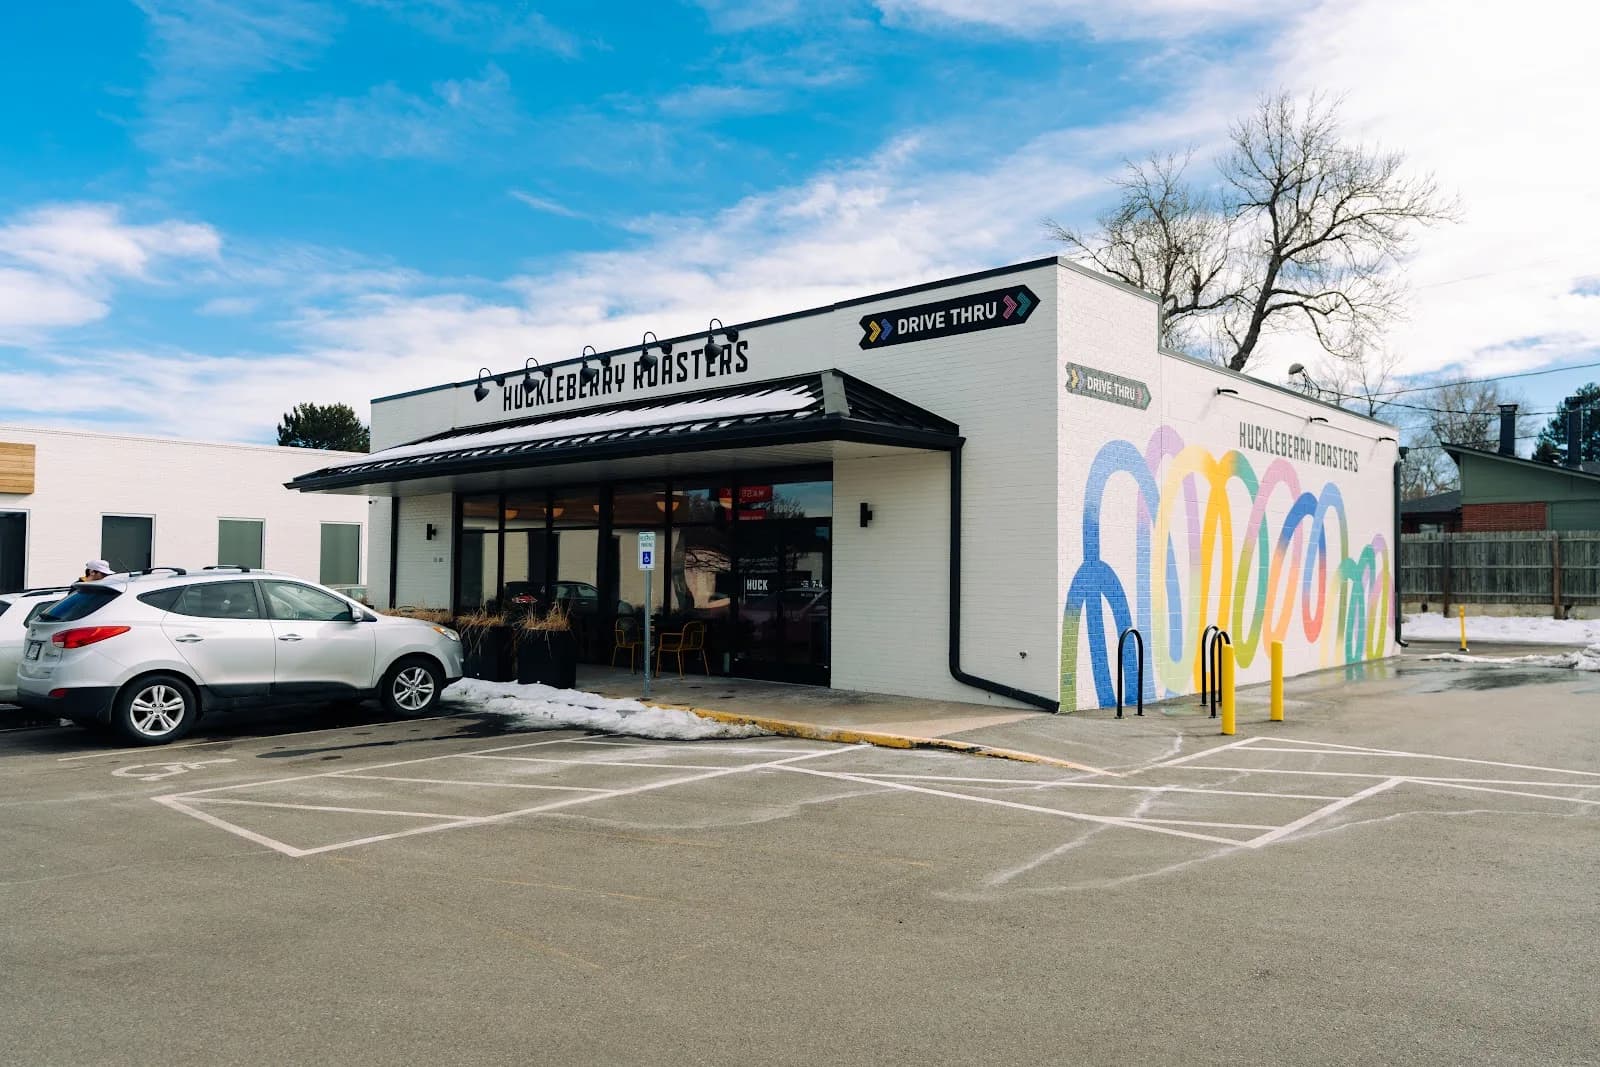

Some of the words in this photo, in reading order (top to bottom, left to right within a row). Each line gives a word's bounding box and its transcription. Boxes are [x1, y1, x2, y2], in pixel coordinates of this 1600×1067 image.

[897, 310, 945, 336] DRIVE
[950, 301, 998, 326] THRU
[633, 340, 749, 390] ROASTERS
[1087, 376, 1112, 395] DRIVE
[1113, 383, 1136, 401] THRU
[1239, 421, 1312, 463] HUCKLEBERRY
[1315, 441, 1359, 473] ROASTERS
[746, 579, 769, 591] HUCK
